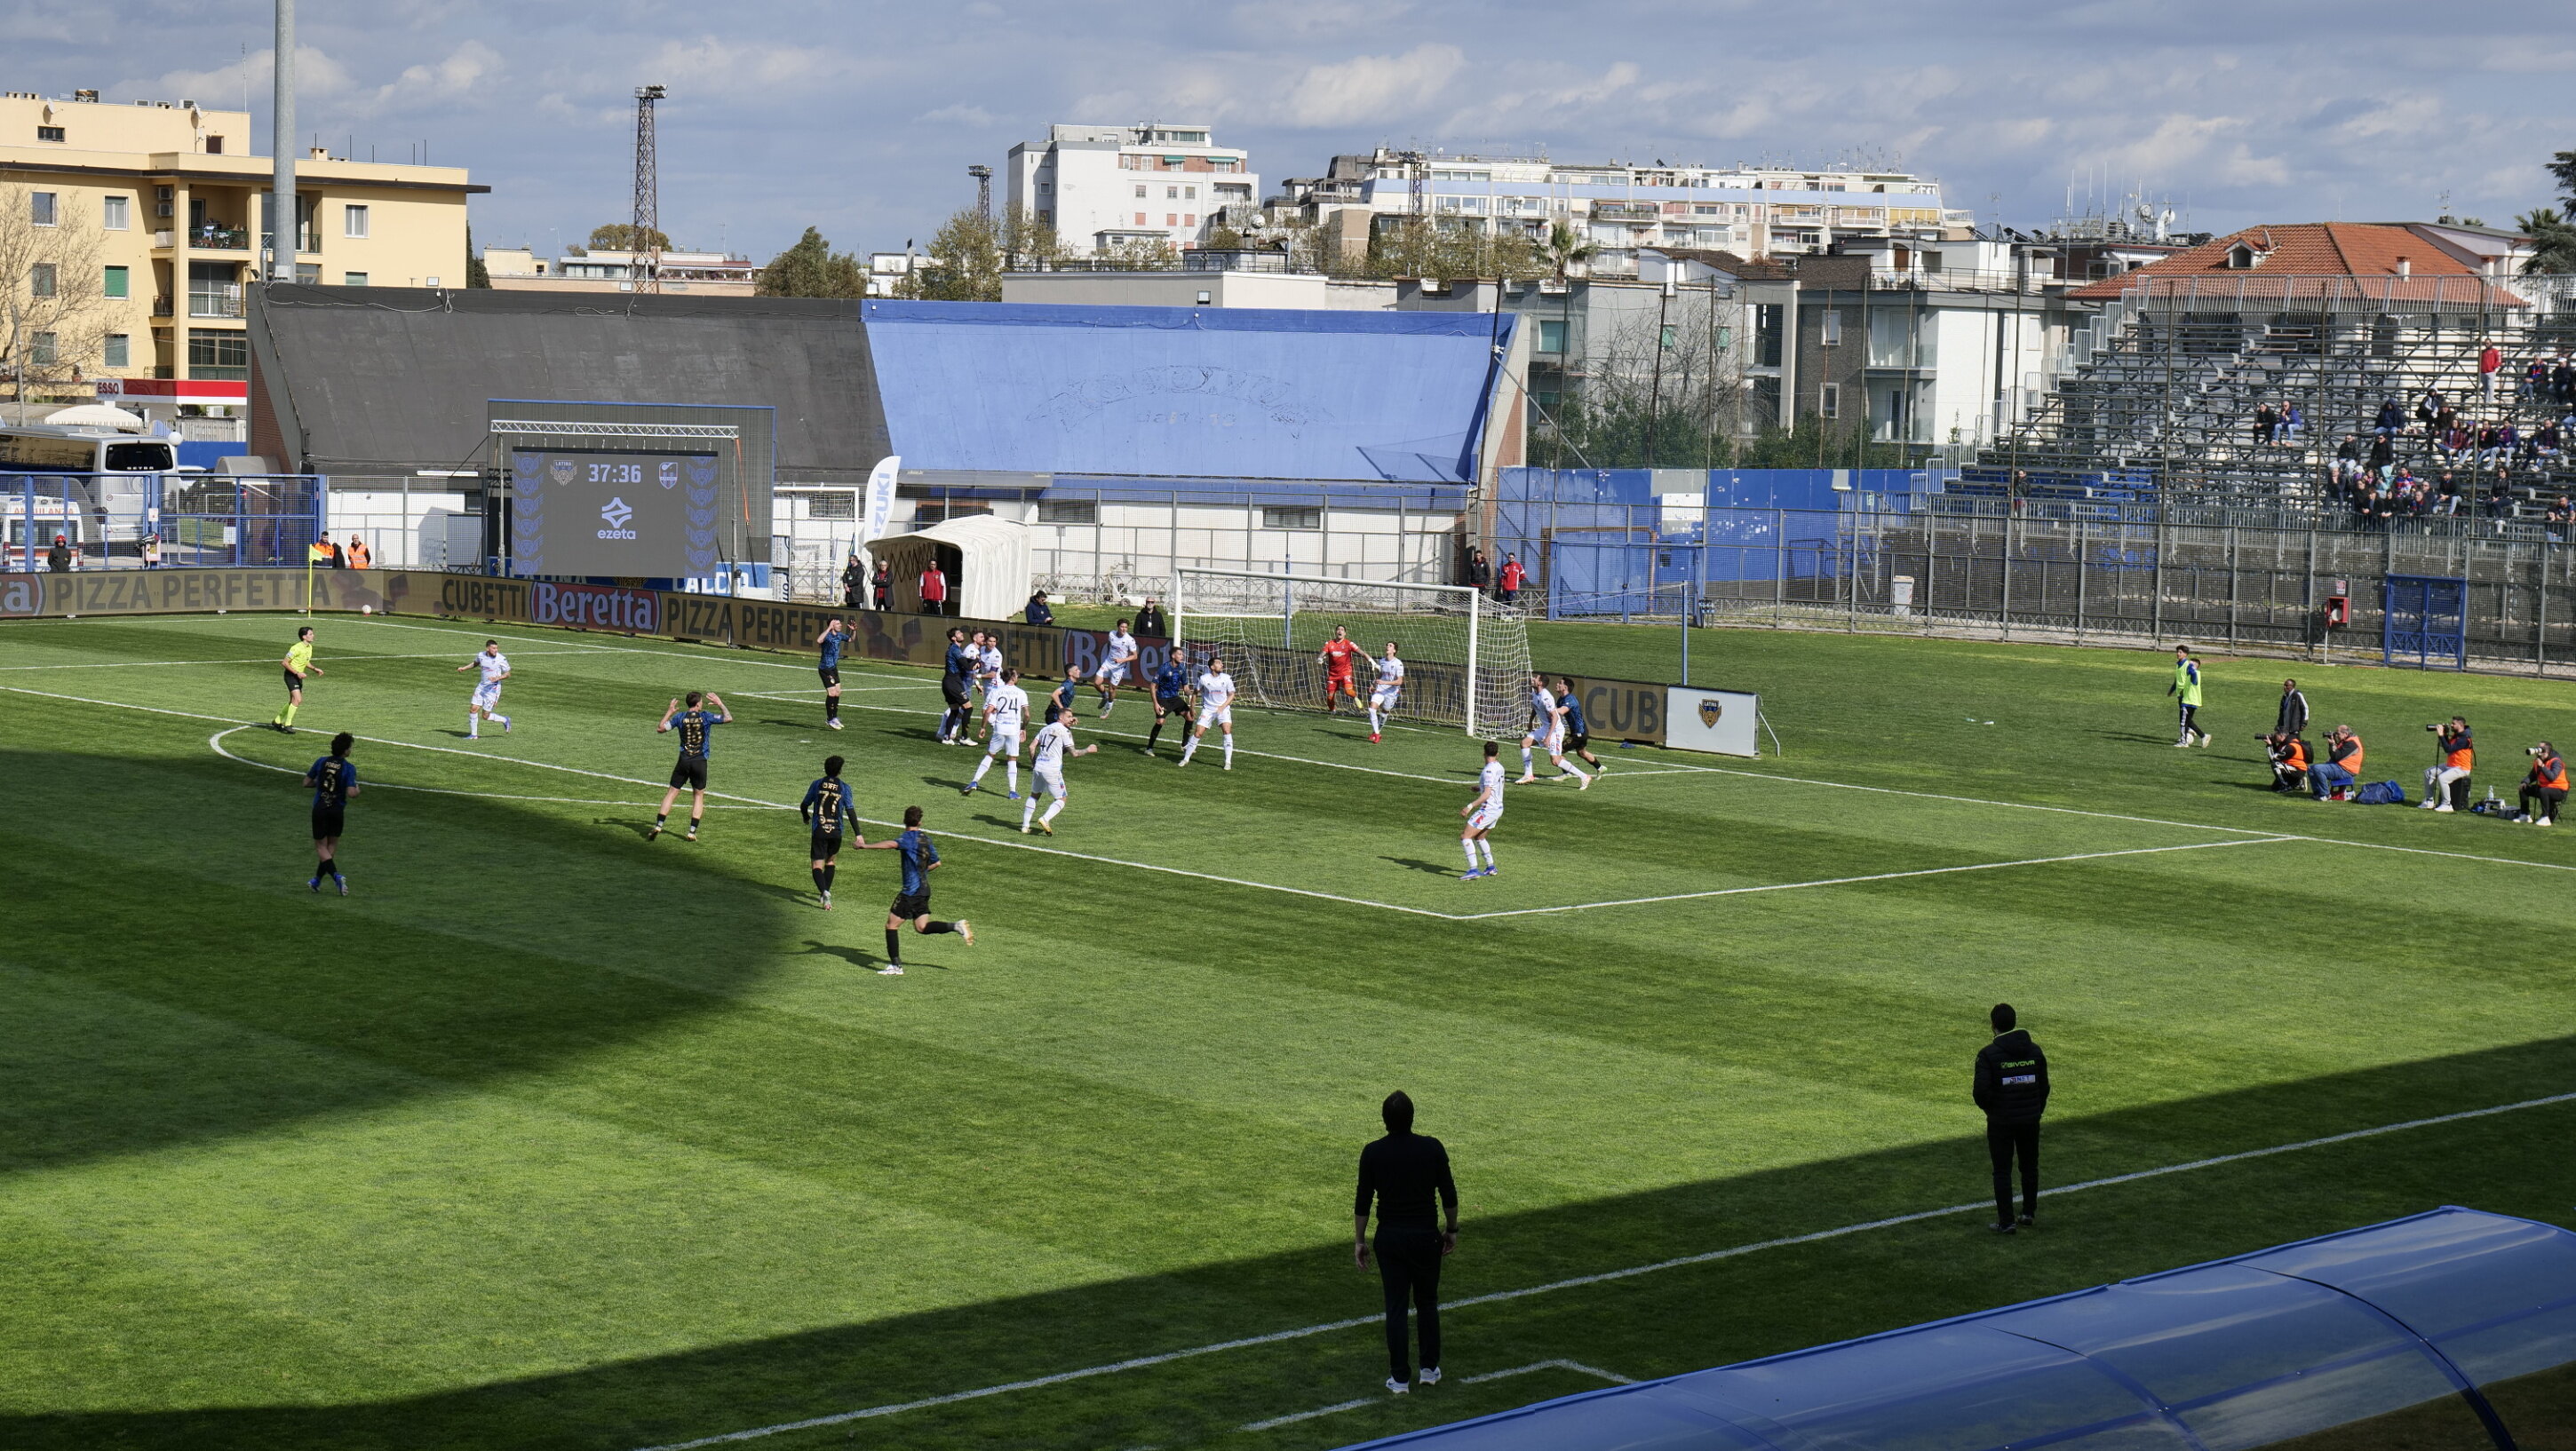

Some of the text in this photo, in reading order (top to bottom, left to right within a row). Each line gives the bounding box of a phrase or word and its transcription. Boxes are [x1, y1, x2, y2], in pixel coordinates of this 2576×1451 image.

[97, 383, 120, 395] ESSO
[588, 464, 641, 483] 37:36
[597, 528, 637, 540] ezeta
[54, 573, 331, 611] PIZZA PERFETTA
[672, 571, 750, 594] CALCO
[443, 578, 527, 617] CUBETTI
[535, 582, 655, 631] Beretta
[667, 598, 733, 638] PIZZA
[959, 624, 1058, 671] BETTI
[998, 696, 1019, 715] 24
[1039, 733, 1057, 752] 47
[818, 790, 842, 816] 77
